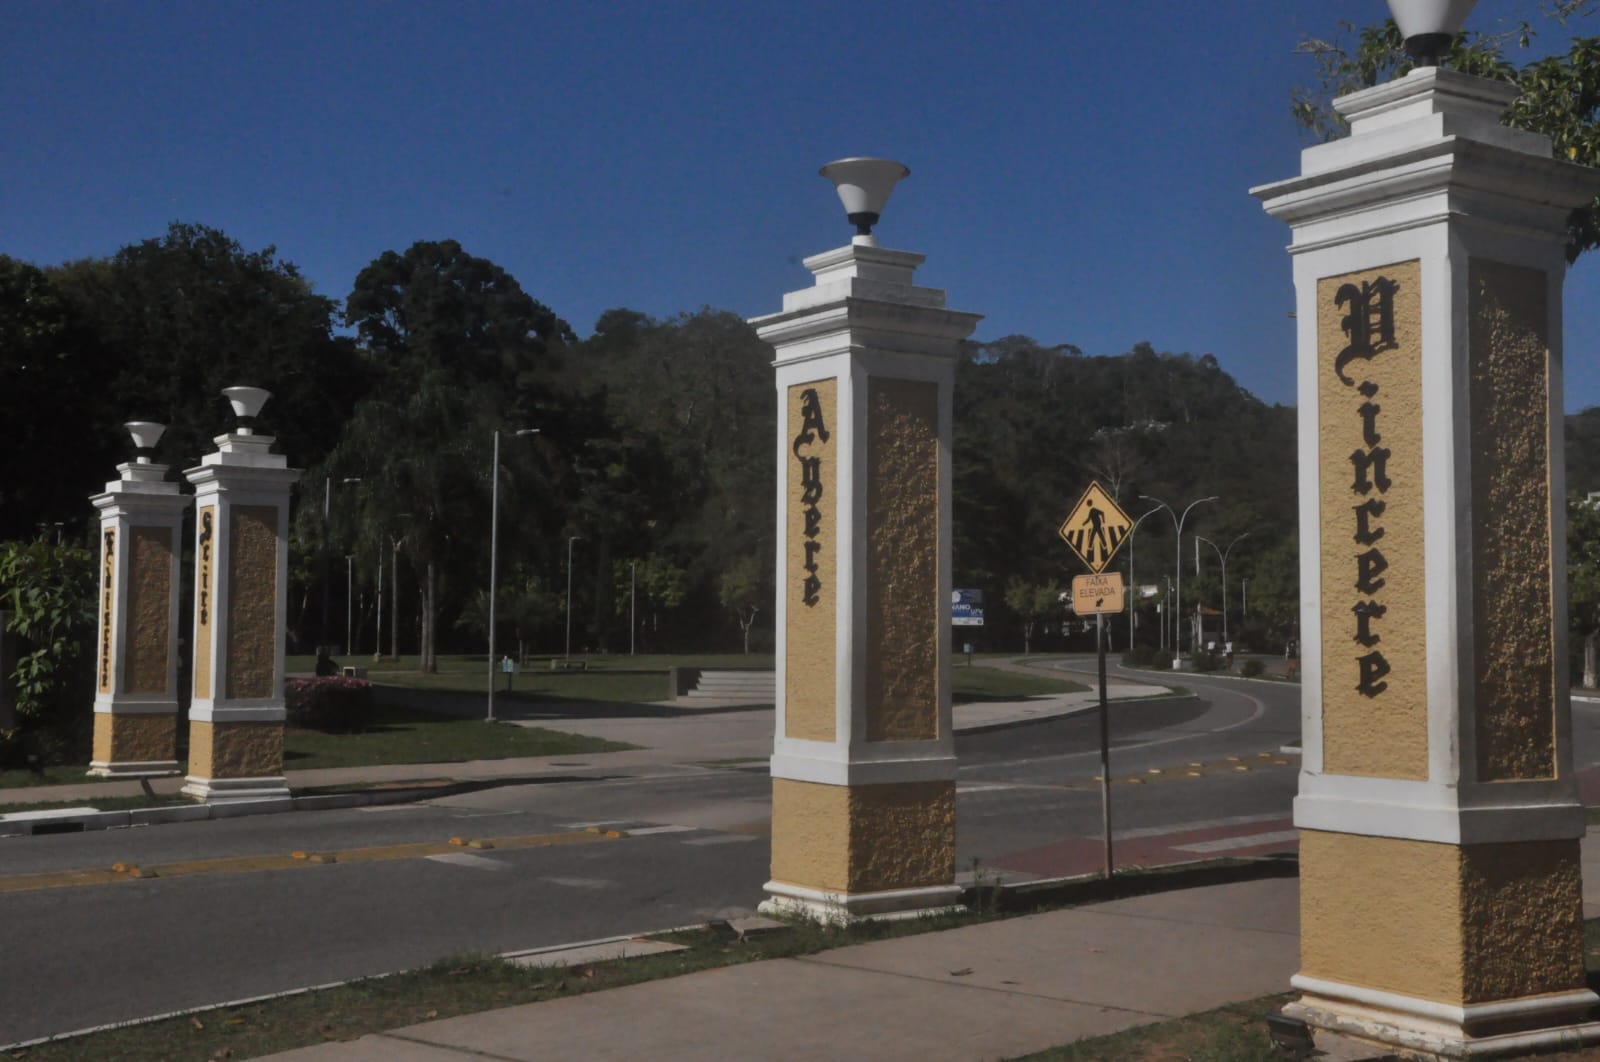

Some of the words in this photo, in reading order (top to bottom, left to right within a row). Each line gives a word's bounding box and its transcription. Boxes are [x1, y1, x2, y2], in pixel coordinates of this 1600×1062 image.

[1335, 275, 1400, 699] Vincere
[1086, 577, 1109, 586] FAIXA
[1080, 587, 1115, 598] ELEVADA
